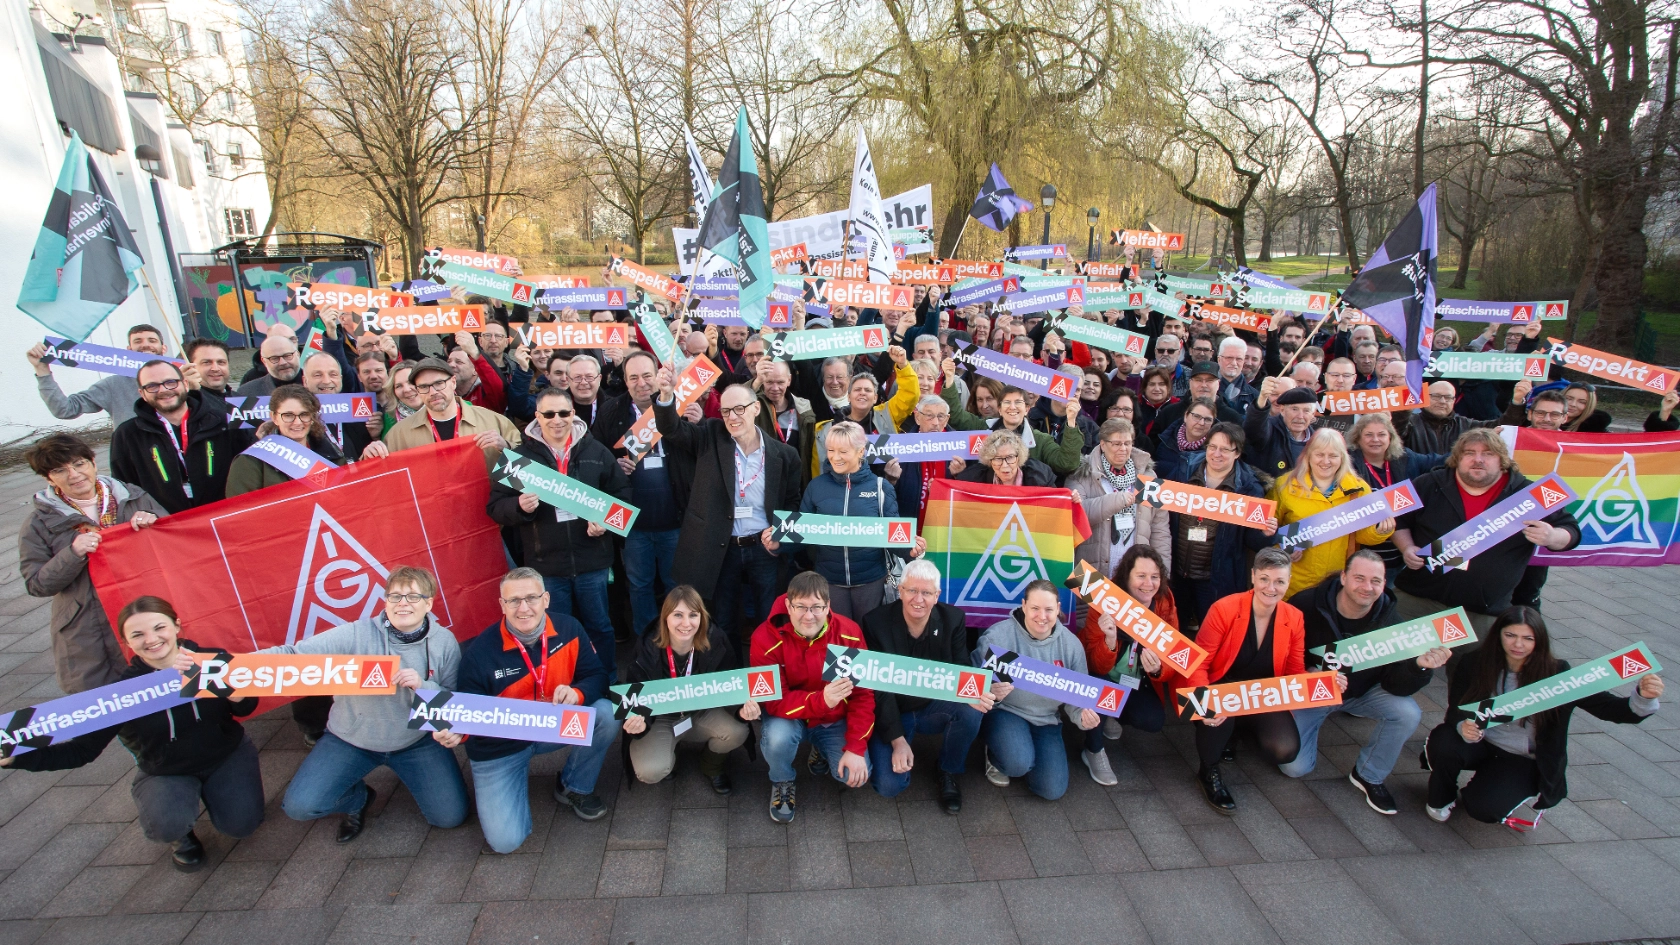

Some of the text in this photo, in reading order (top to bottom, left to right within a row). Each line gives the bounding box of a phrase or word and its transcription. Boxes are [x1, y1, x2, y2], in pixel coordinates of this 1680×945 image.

[1005, 247, 1053, 258] Antirassismus
[1115, 230, 1167, 248] Vielfalt
[429, 264, 511, 292] Menschlichkeit
[612, 258, 668, 292] Respekt
[295, 287, 389, 310] Respekt
[811, 279, 891, 305] Vielfalt
[938, 284, 1003, 308] Antirassismus
[992, 291, 1066, 314] Antirassismus
[1237, 291, 1308, 306] Solidarität
[361, 308, 460, 334] Respekt
[684, 305, 742, 318] Antifaschis
[1190, 303, 1257, 327] Respekt
[517, 324, 604, 347] Vielfalt
[771, 330, 863, 358] Solidarität
[1050, 317, 1125, 344] Menschlichkeit
[44, 343, 149, 371] Antifaschism
[952, 348, 1049, 387] Antifaschismus
[1425, 354, 1522, 374] Solidarität
[1549, 342, 1650, 383] Respekt
[1315, 389, 1401, 414] Vielfalt
[866, 438, 967, 456] Antifaschismus
[503, 460, 607, 513] Menschlichkeit
[1142, 480, 1246, 518] Respekt
[780, 518, 884, 536] Menschlichkeit
[1282, 498, 1386, 549] Antifaschismus
[1426, 498, 1537, 571] Antifaschismus
[1080, 567, 1175, 653] Vielfalt
[1323, 622, 1436, 672] Solidarität
[199, 656, 359, 694] Respekt
[835, 653, 956, 692] Solidarität
[983, 653, 1099, 700] Antirassismus
[621, 676, 744, 709] Menschlichkeit
[1186, 676, 1305, 718] Vielfalt
[1475, 665, 1610, 722] Menschlichkeit
[0, 678, 182, 747] Antifaschismus
[412, 702, 558, 729] Antifaschismus
